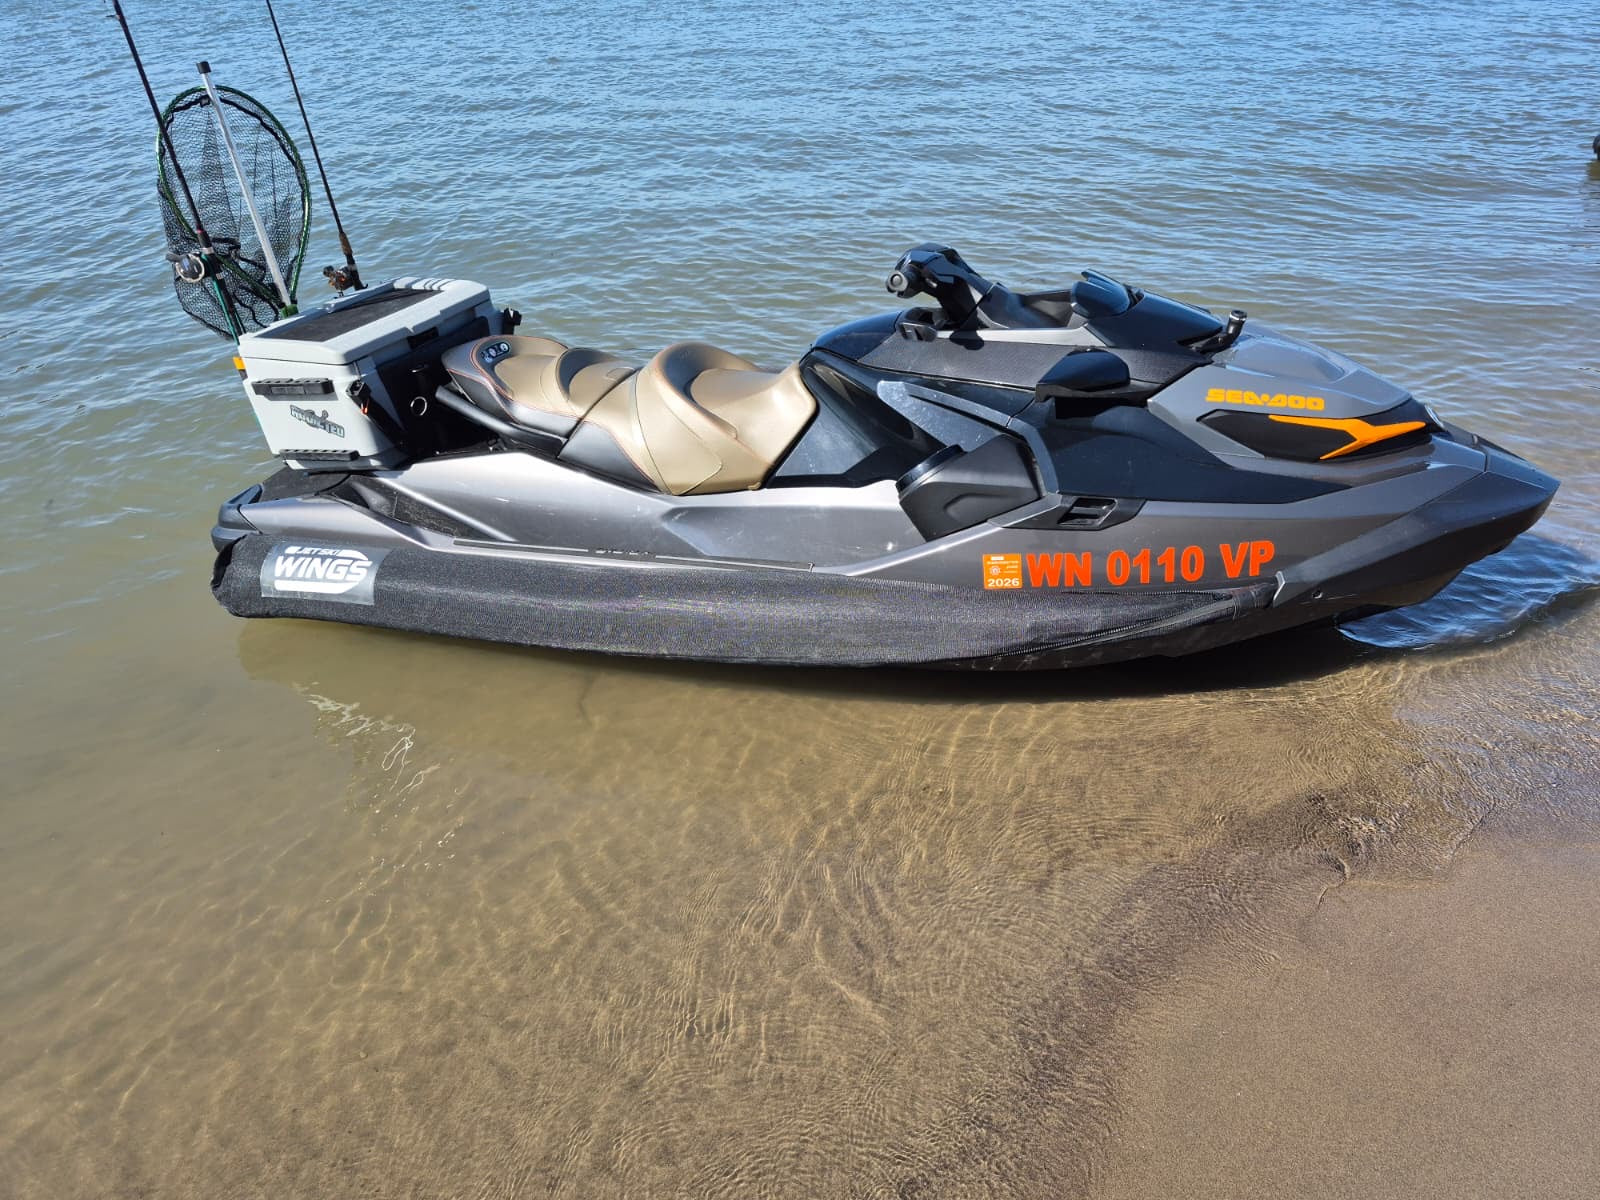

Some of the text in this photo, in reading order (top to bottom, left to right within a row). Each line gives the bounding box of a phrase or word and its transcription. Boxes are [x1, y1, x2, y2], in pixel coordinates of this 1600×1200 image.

[274, 555, 373, 581] WINGS
[1026, 540, 1275, 587] WN 0110 VP
[987, 577, 1020, 587] 2026
